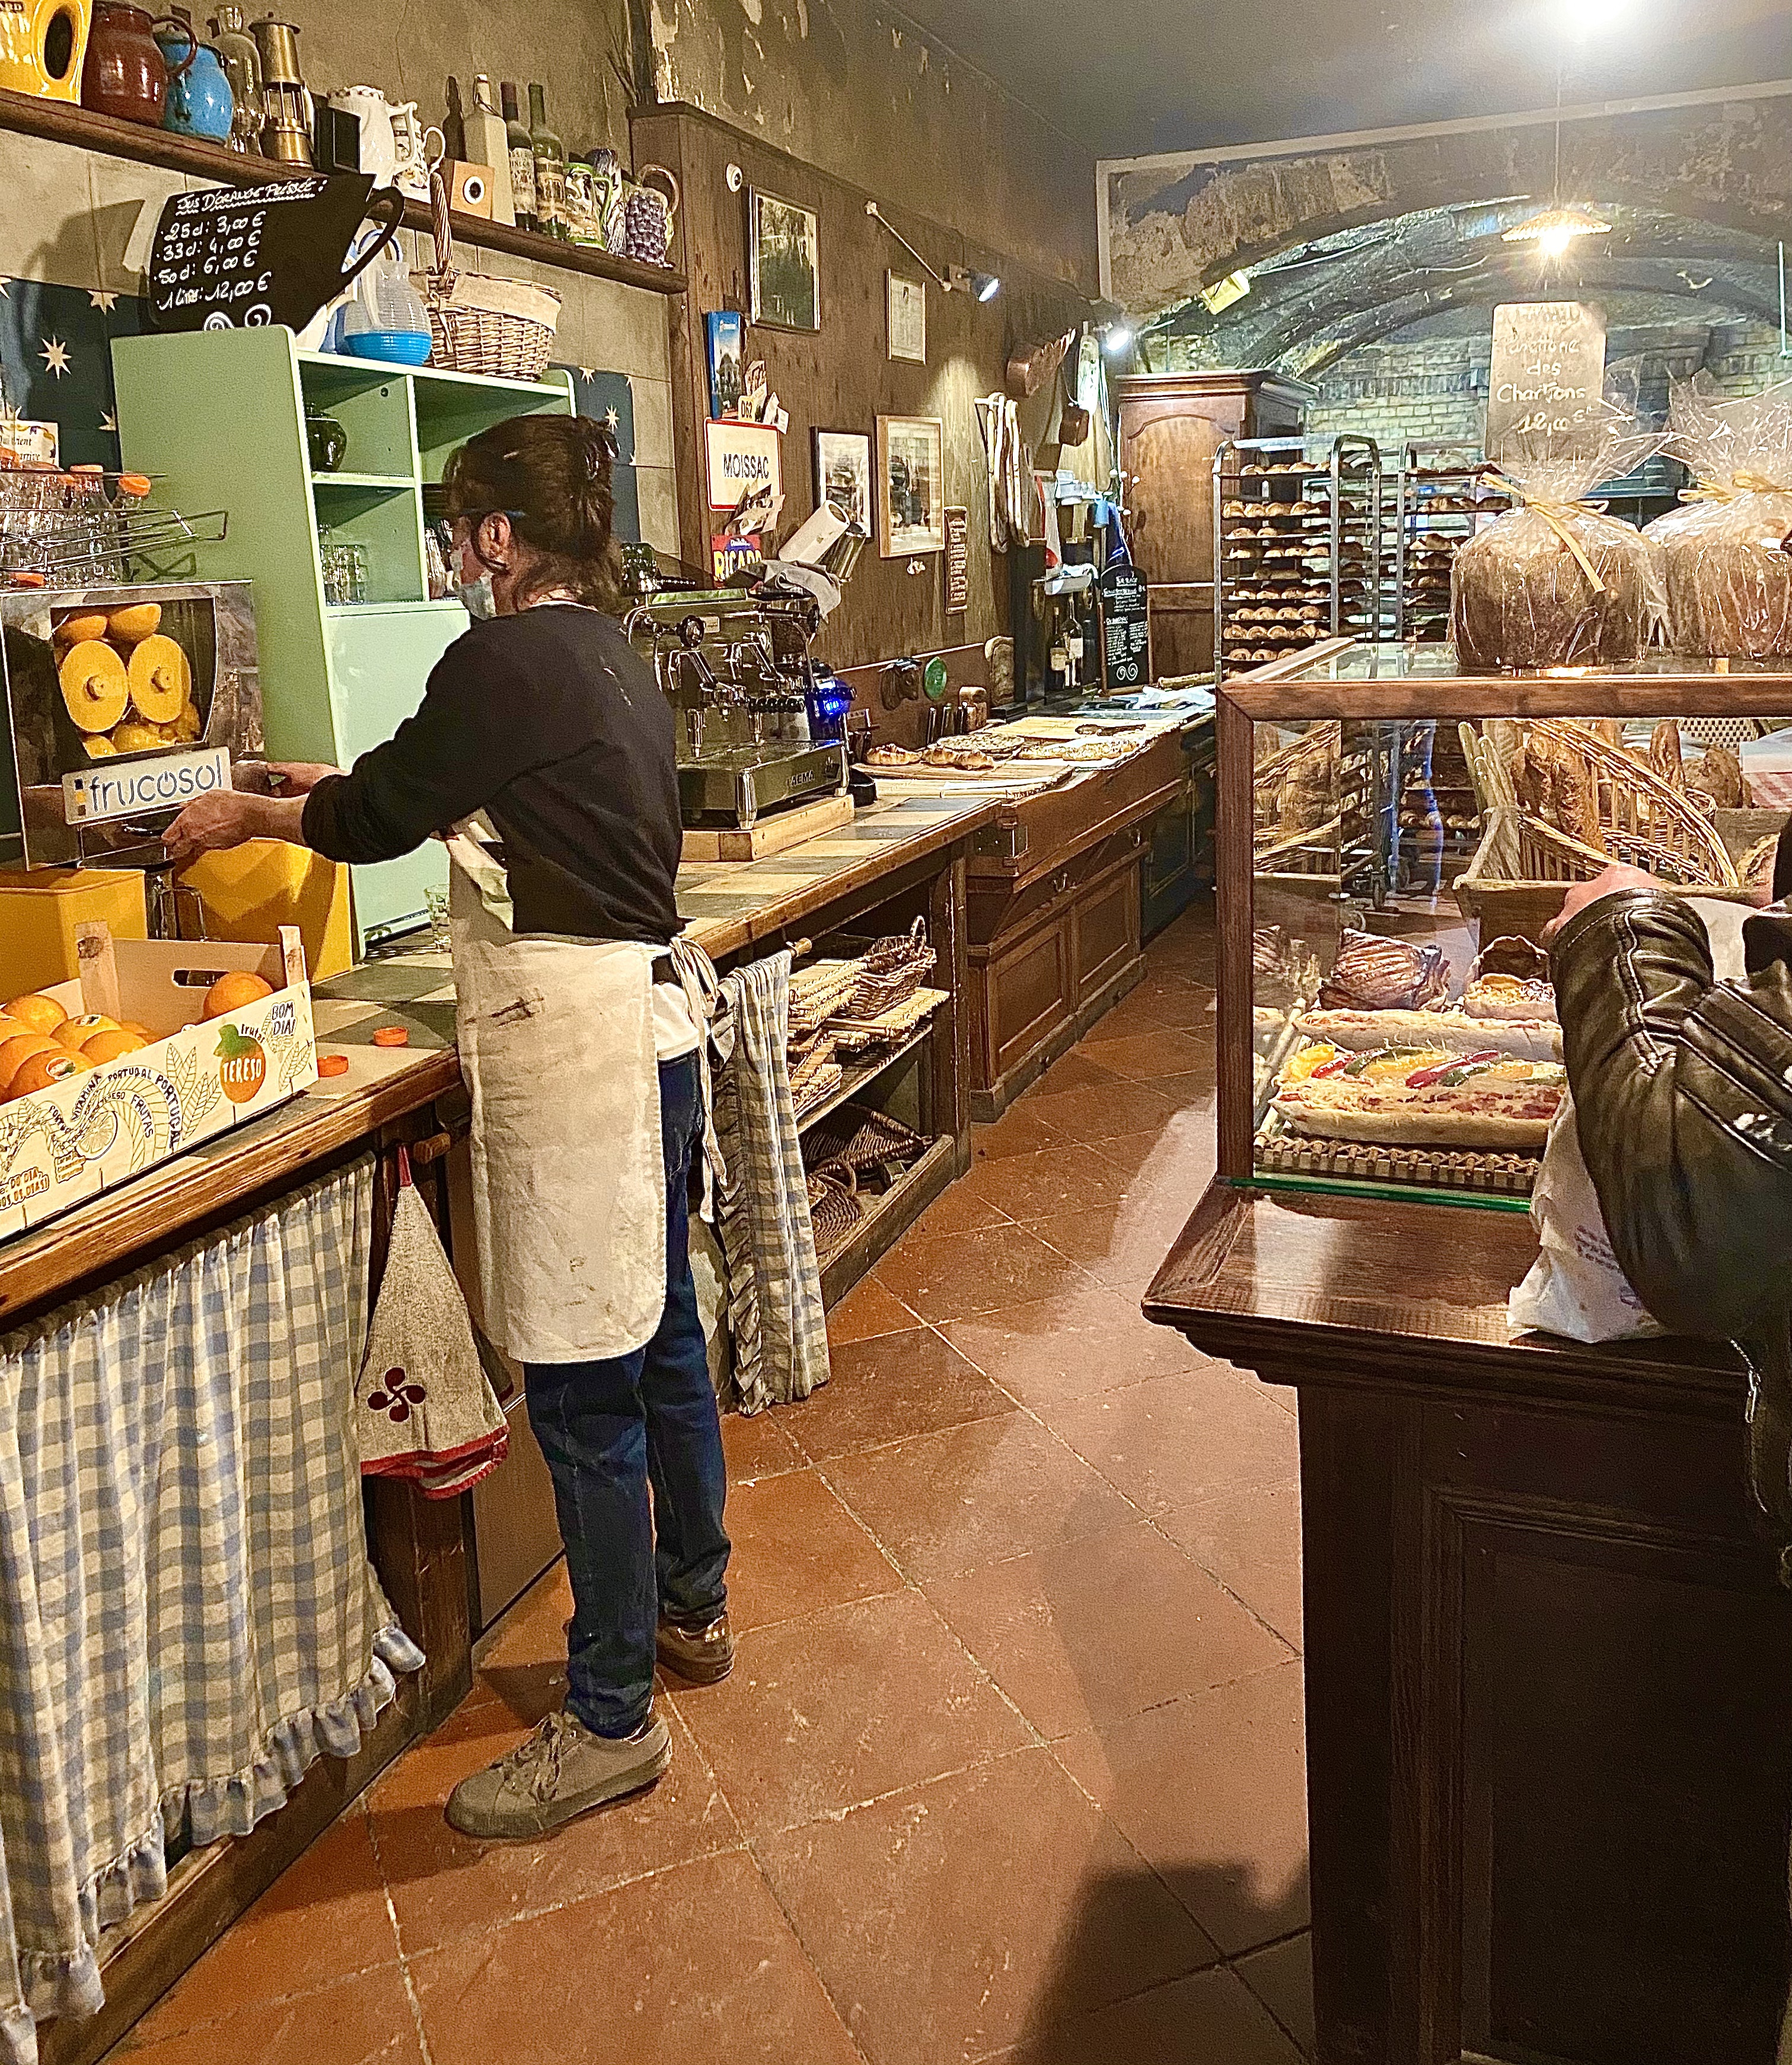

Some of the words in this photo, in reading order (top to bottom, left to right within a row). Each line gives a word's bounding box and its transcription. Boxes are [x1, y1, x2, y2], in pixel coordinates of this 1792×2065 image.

[1526, 359, 1562, 377] des
[723, 454, 770, 479] MOISSAC
[89, 754, 222, 812] frucosol
[272, 1002, 294, 1021] BOM
[222, 1057, 262, 1083] TERESO
[108, 1067, 152, 1082] PORTUGAL
[155, 1074, 181, 1149] PORTUGAL
[130, 1094, 154, 1138] FRUTAS
